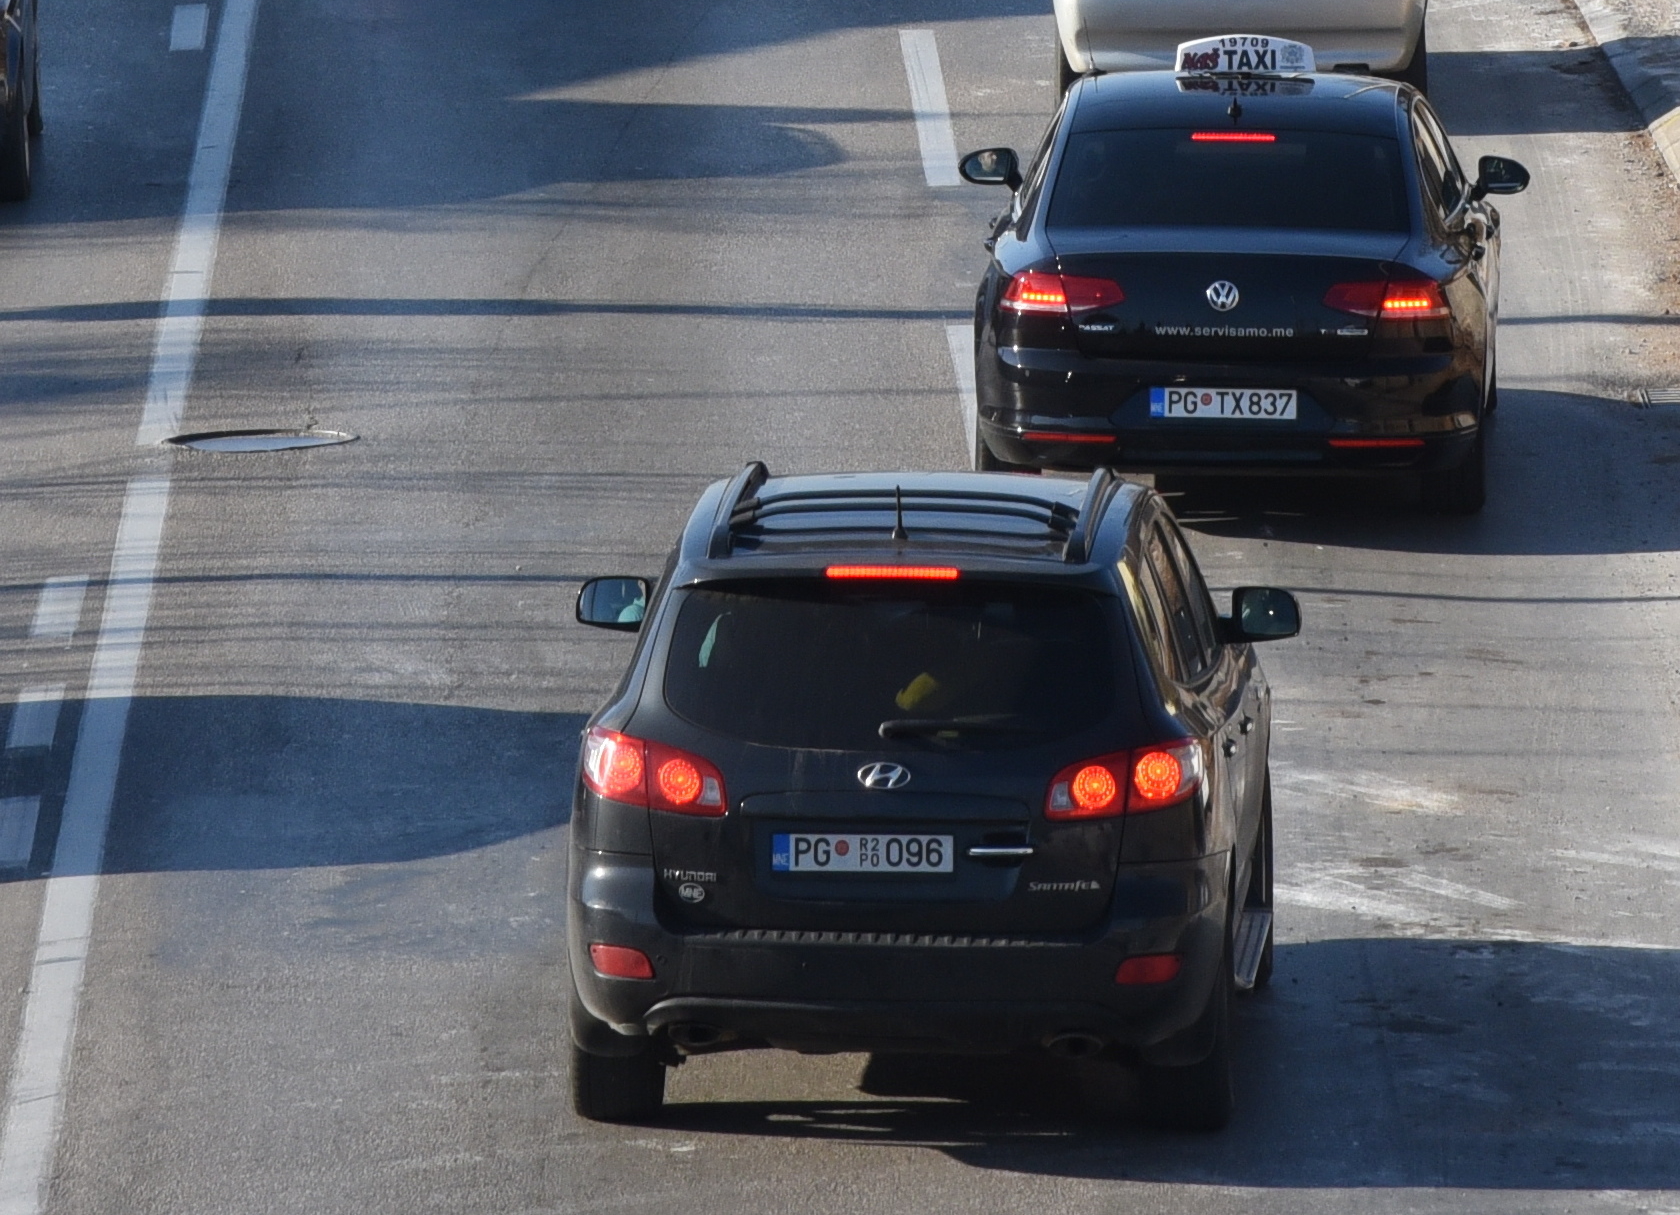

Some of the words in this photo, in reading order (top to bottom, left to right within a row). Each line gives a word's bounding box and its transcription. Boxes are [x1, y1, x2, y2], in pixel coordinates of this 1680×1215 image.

[1219, 36, 1270, 48] 19709
[1223, 49, 1277, 71] TAXI
[1155, 325, 1294, 338] www.servisamo.me
[1168, 391, 1198, 415] PG
[1216, 391, 1293, 417] TX837
[794, 837, 832, 867] PG
[859, 837, 880, 851] R2
[885, 837, 943, 868] 096
[663, 868, 717, 883] HYUNDAI
